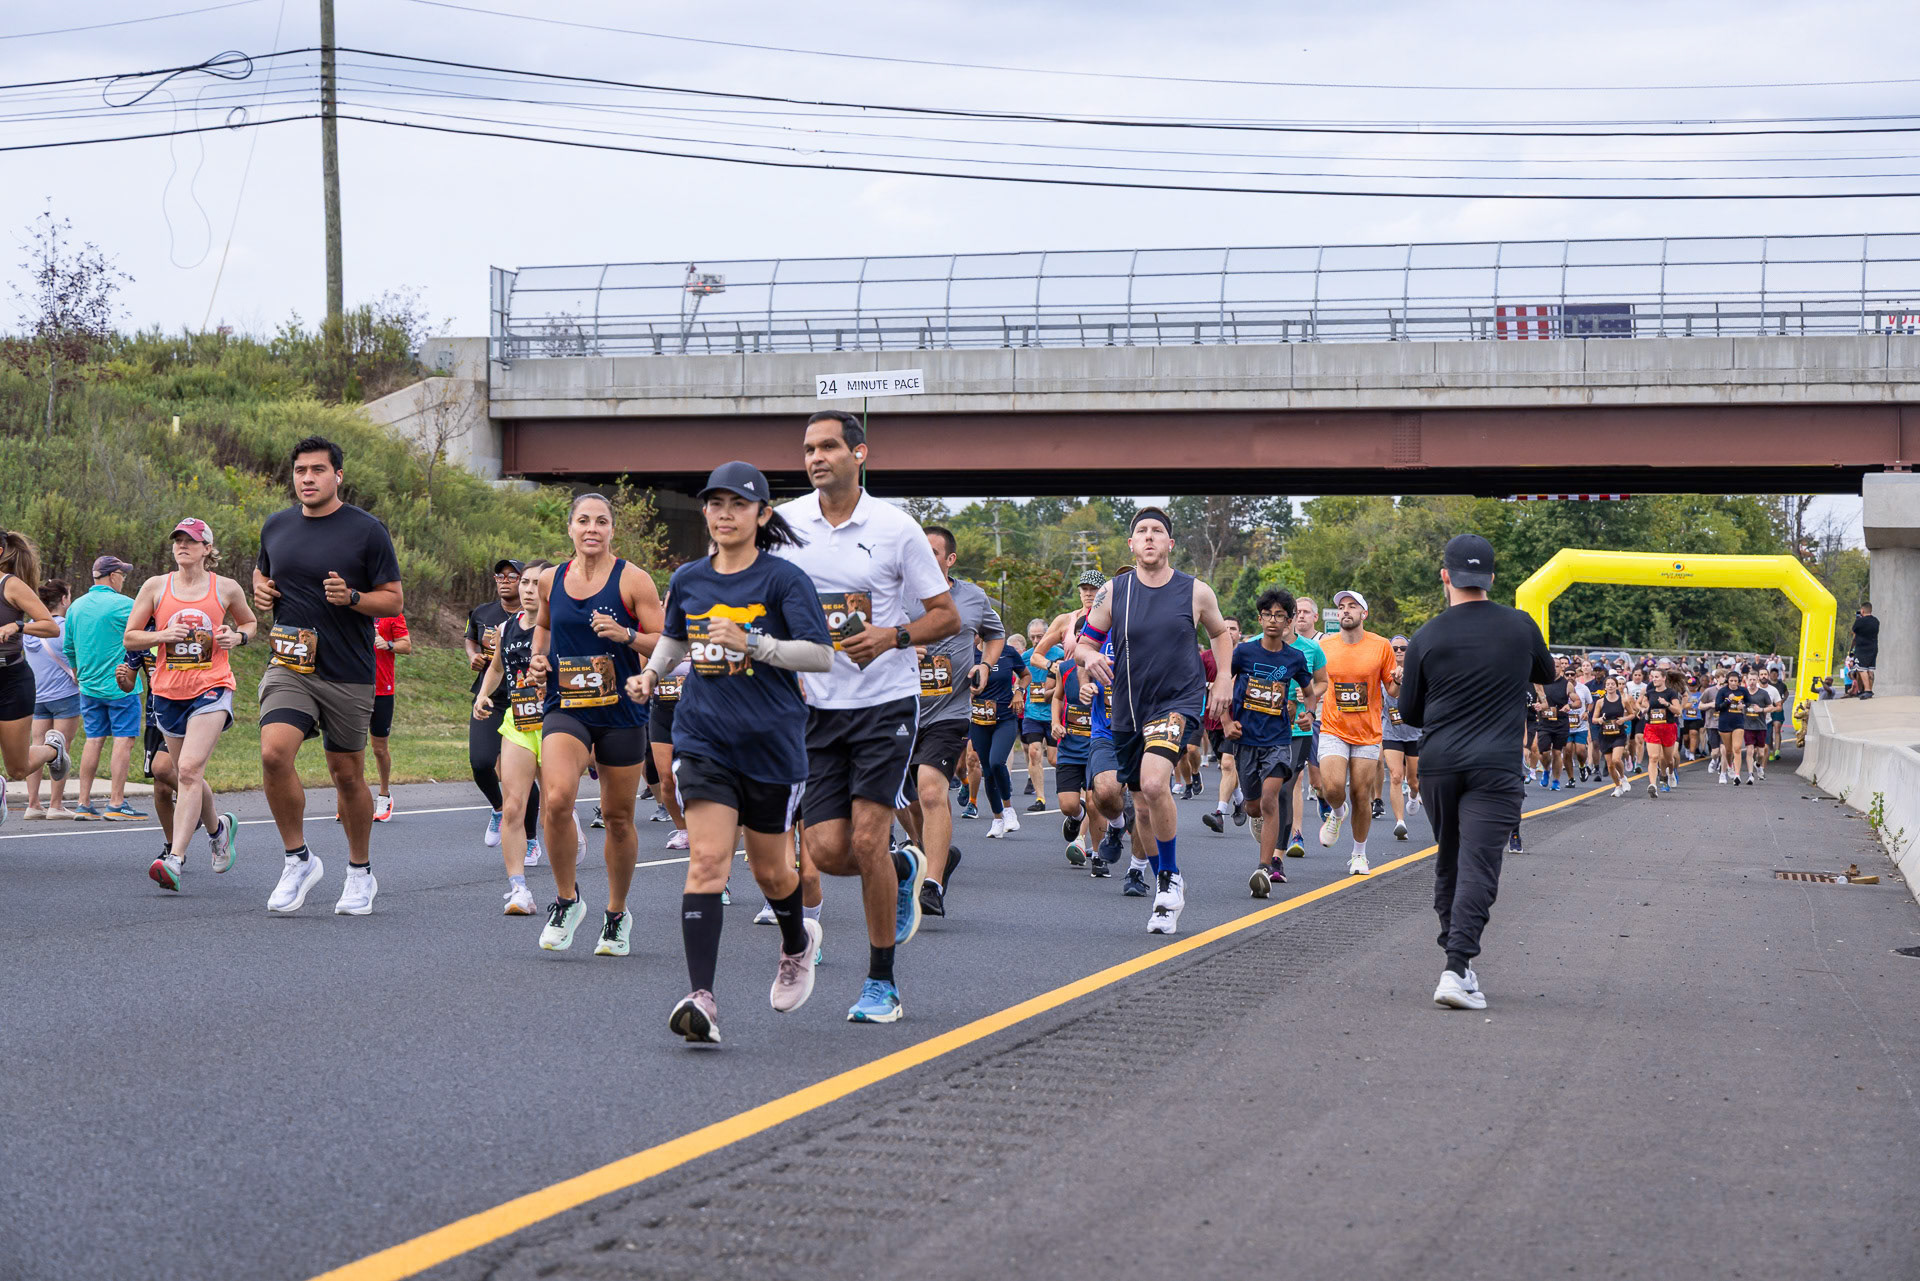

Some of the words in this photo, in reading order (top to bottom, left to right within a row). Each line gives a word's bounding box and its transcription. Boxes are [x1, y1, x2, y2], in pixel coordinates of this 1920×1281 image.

[819, 380, 838, 395] 24
[847, 380, 889, 391] MINUTE
[894, 377, 920, 390] PACE
[174, 642, 202, 654] 66
[275, 640, 308, 656] 172
[570, 672, 603, 688] 43
[920, 668, 948, 680] 55
[1250, 688, 1282, 702] 347
[1341, 692, 1360, 700] 80
[972, 706, 994, 716] 244
